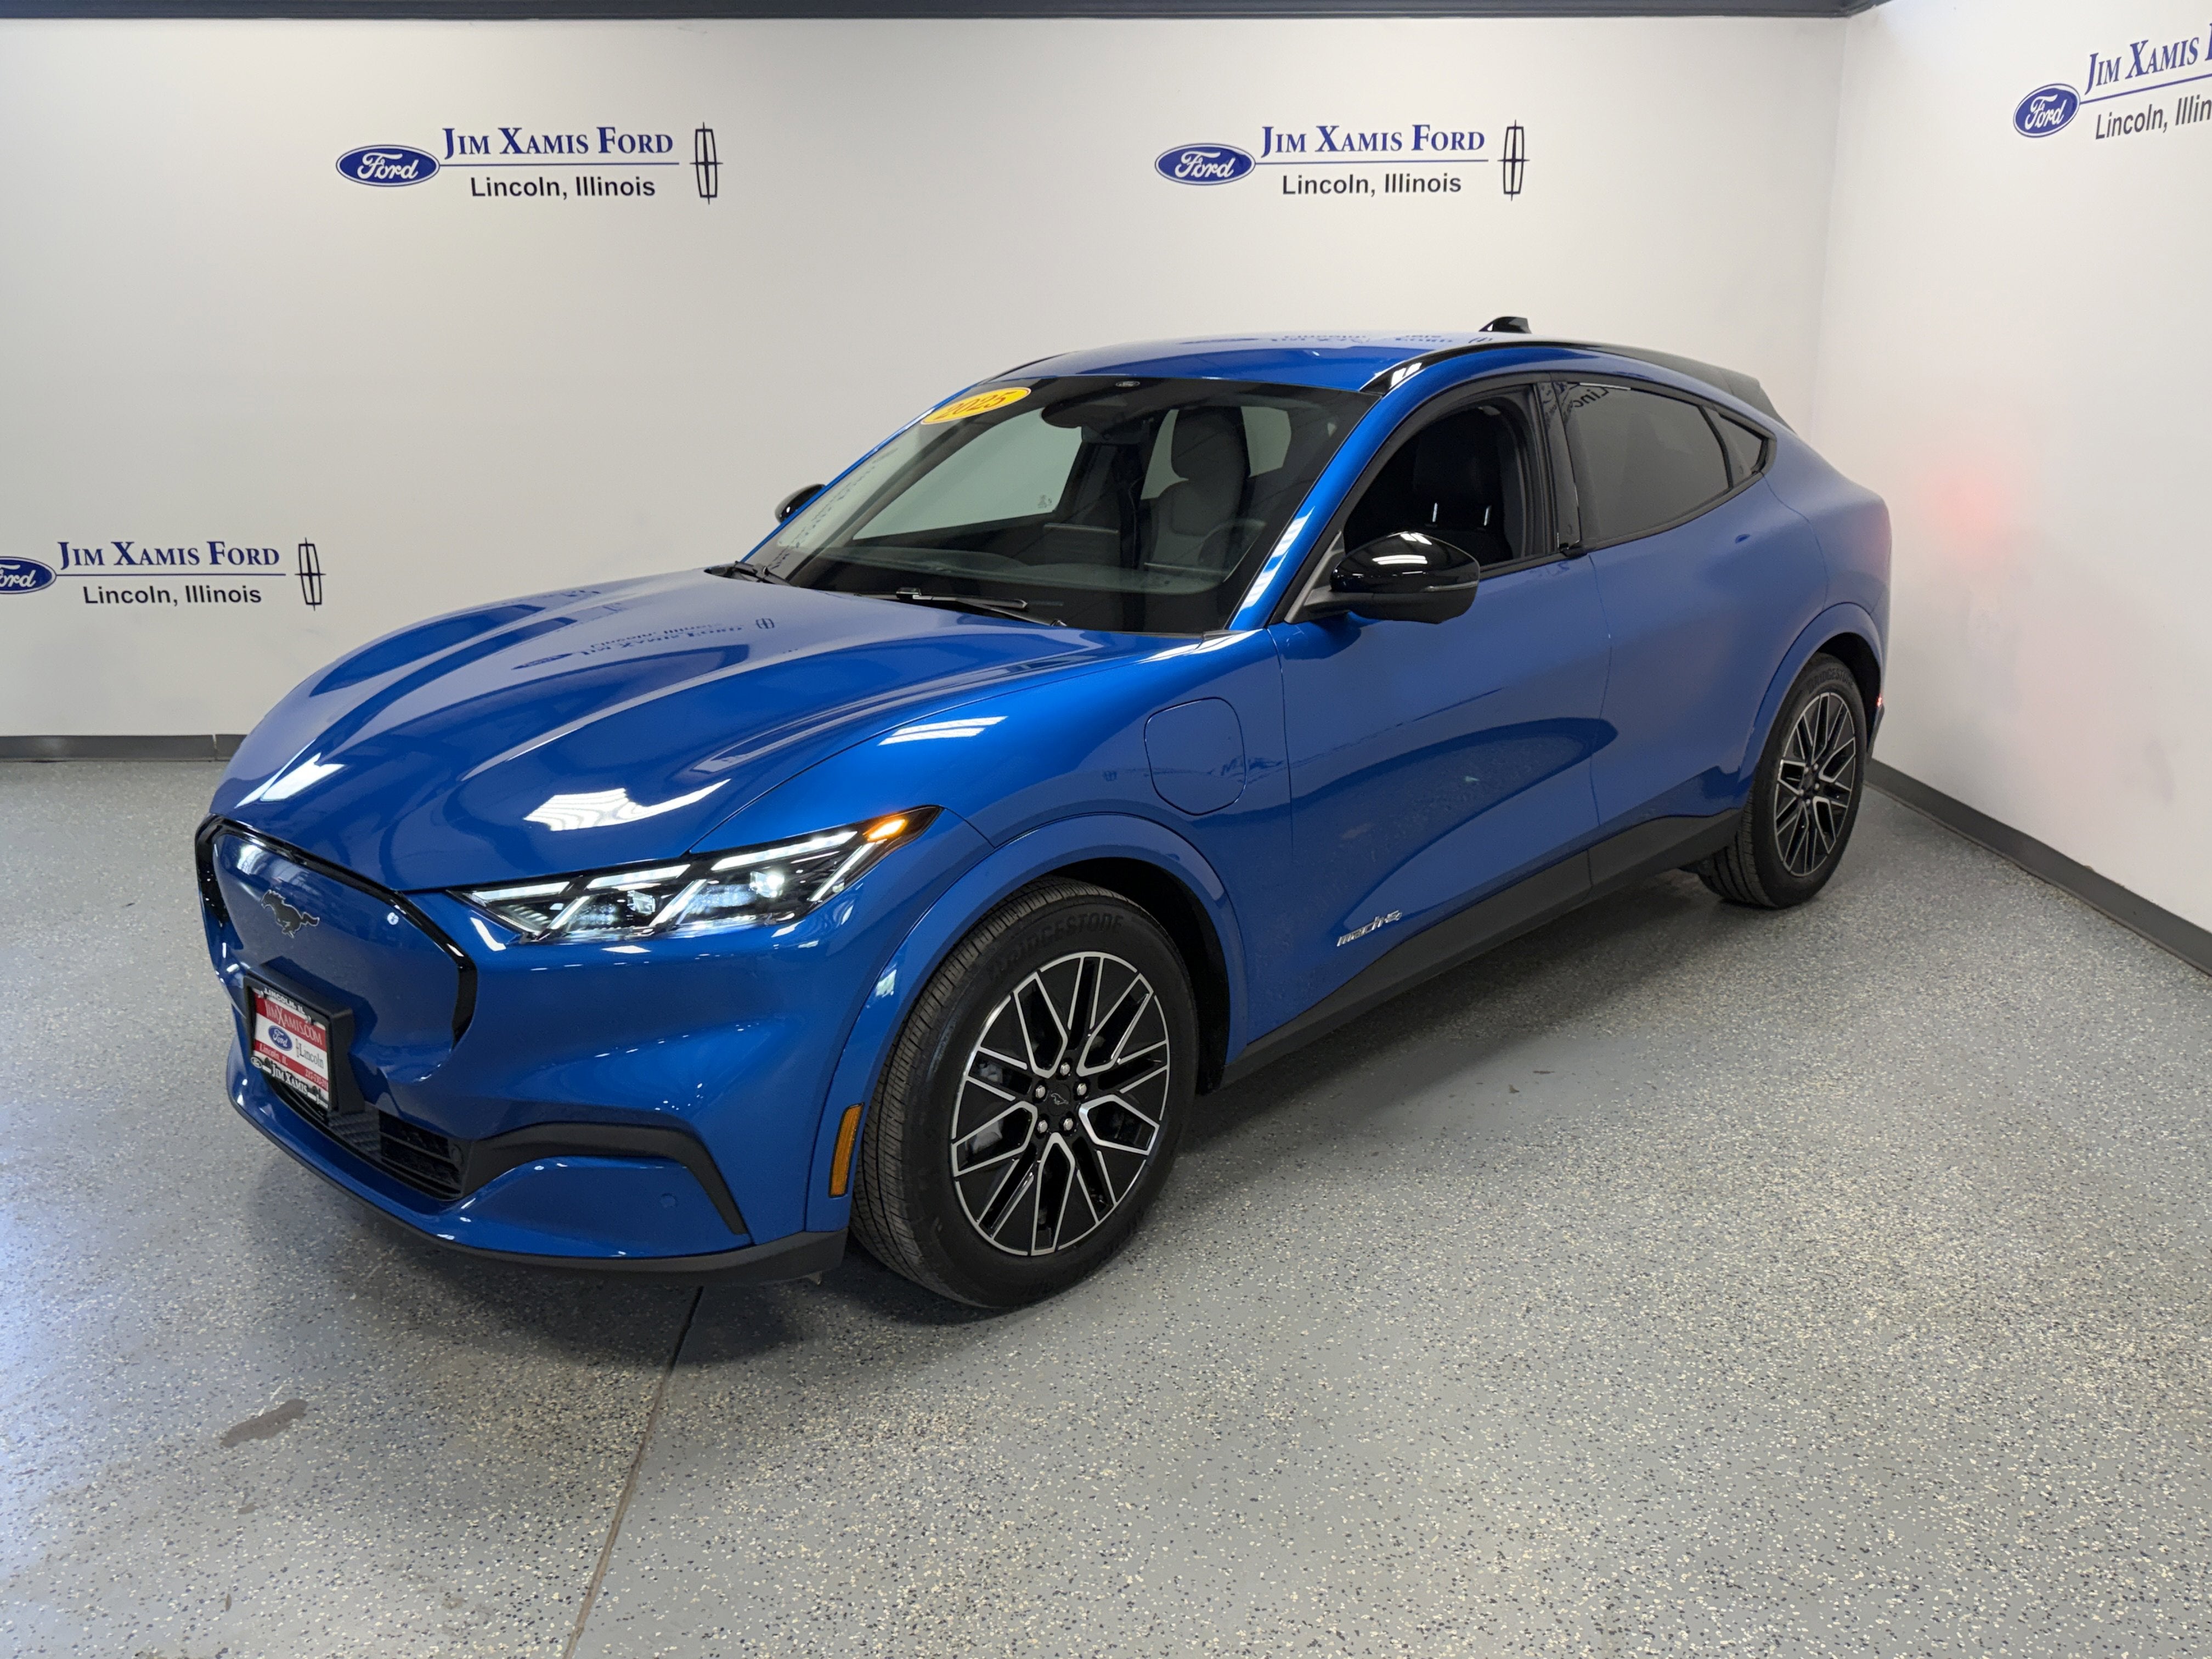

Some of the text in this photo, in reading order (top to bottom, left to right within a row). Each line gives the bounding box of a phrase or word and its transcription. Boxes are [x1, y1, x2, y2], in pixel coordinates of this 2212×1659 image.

[2084, 52, 2121, 95] JIM
[2125, 37, 2199, 80] XAMIS
[2024, 94, 2067, 130] Ford
[2095, 94, 2212, 139] Lincoln, Illin
[442, 126, 673, 160] JIM XAMIS FORD
[1260, 124, 1485, 159] JIM XAMIS FORD
[357, 152, 419, 181] Ford
[1175, 150, 1236, 179] Ford
[471, 176, 656, 201] Lincoln, Illinois
[1283, 172, 1462, 198] Lincoln, Illinois
[933, 391, 1017, 420] 2025
[57, 541, 280, 571] JIM XAMIS FORD
[83, 585, 262, 607] Lincoln, Illinois
[272, 1029, 288, 1048] Ford
[298, 1042, 324, 1069] Lincoln
[285, 1071, 308, 1095] XAMIS
